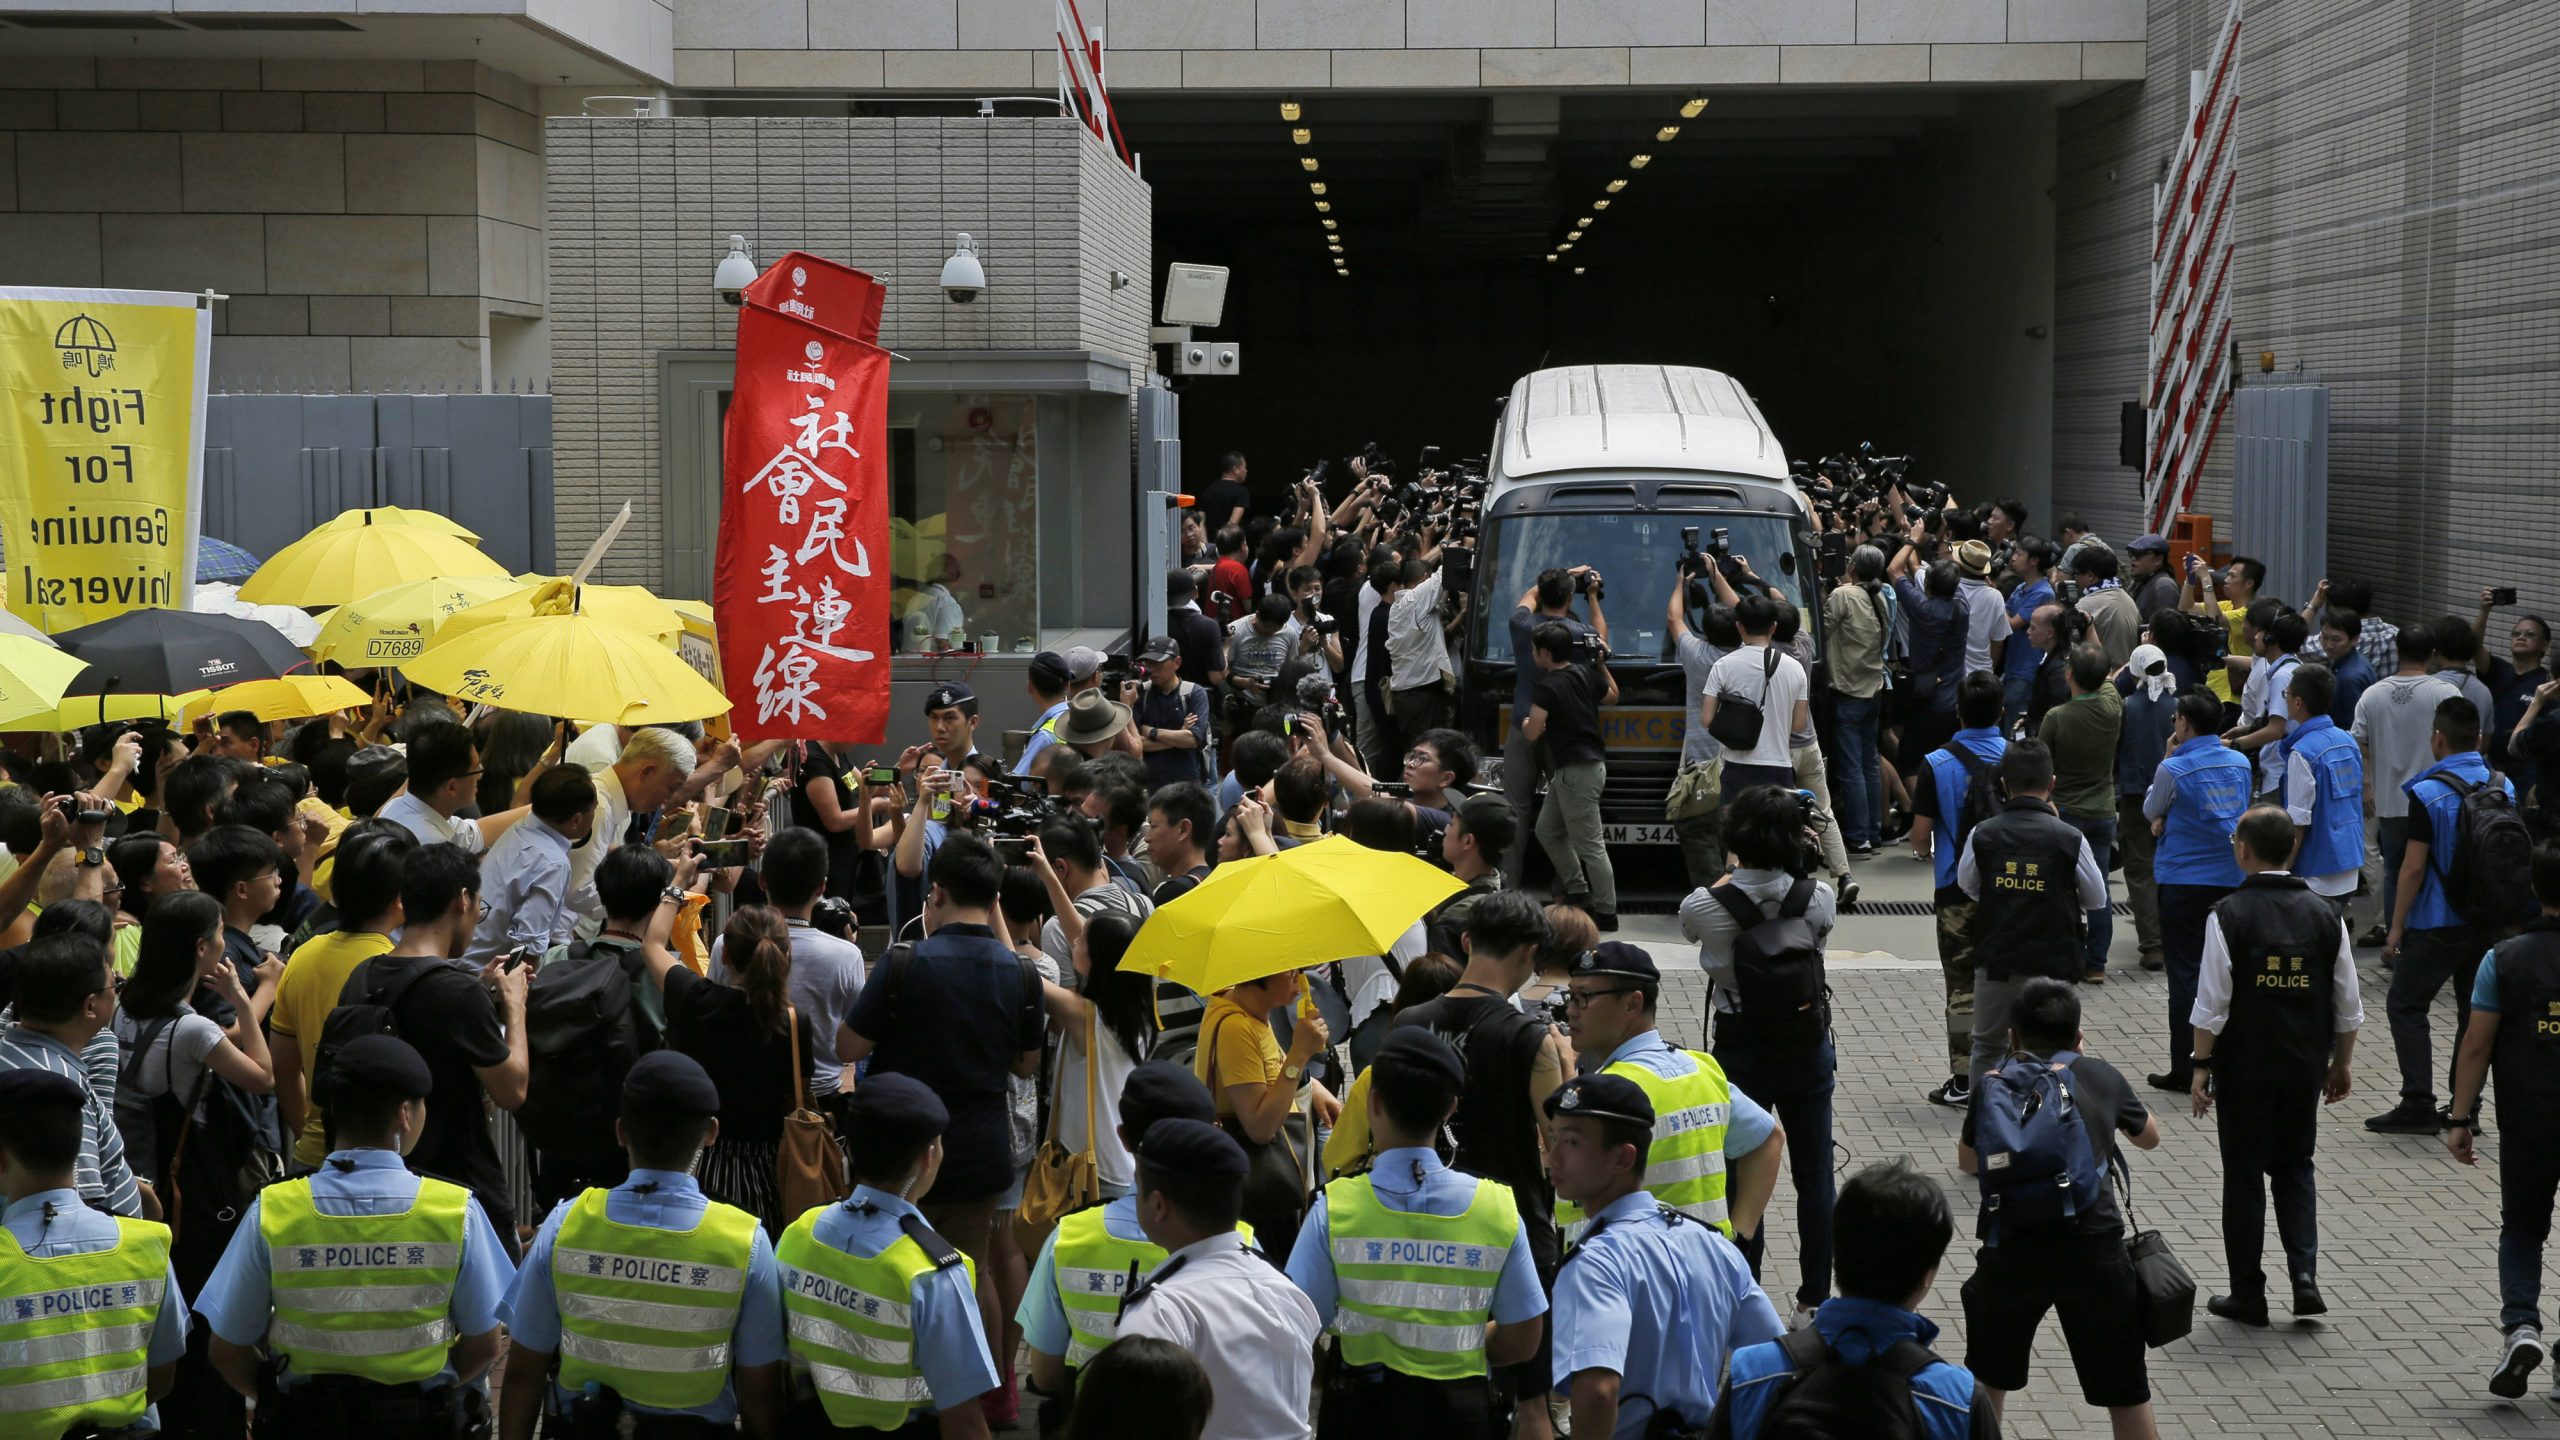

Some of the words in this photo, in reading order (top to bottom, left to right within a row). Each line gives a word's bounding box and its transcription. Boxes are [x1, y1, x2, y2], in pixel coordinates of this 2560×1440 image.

[369, 640, 421, 656] D7689
[198, 662, 236, 675] TISSOT
[1603, 827, 1627, 841] AM
[1995, 876, 2046, 891] POLICE
[2256, 974, 2310, 988] POLICE
[299, 1248, 317, 1268] 警
[326, 1246, 397, 1266] POLICE
[407, 1246, 425, 1264] 察
[1366, 1242, 1383, 1261] 警
[1391, 1241, 1456, 1265] POLICE
[1464, 1247, 1482, 1267] 察
[588, 1254, 605, 1275] 警
[612, 1257, 682, 1284] POLICE
[690, 1266, 709, 1286] 察
[15, 1298, 34, 1319] 警
[43, 1287, 113, 1315] POLICE
[121, 1285, 137, 1304] 察
[802, 1274, 859, 1310] POLICE
[863, 1296, 879, 1318] 察
